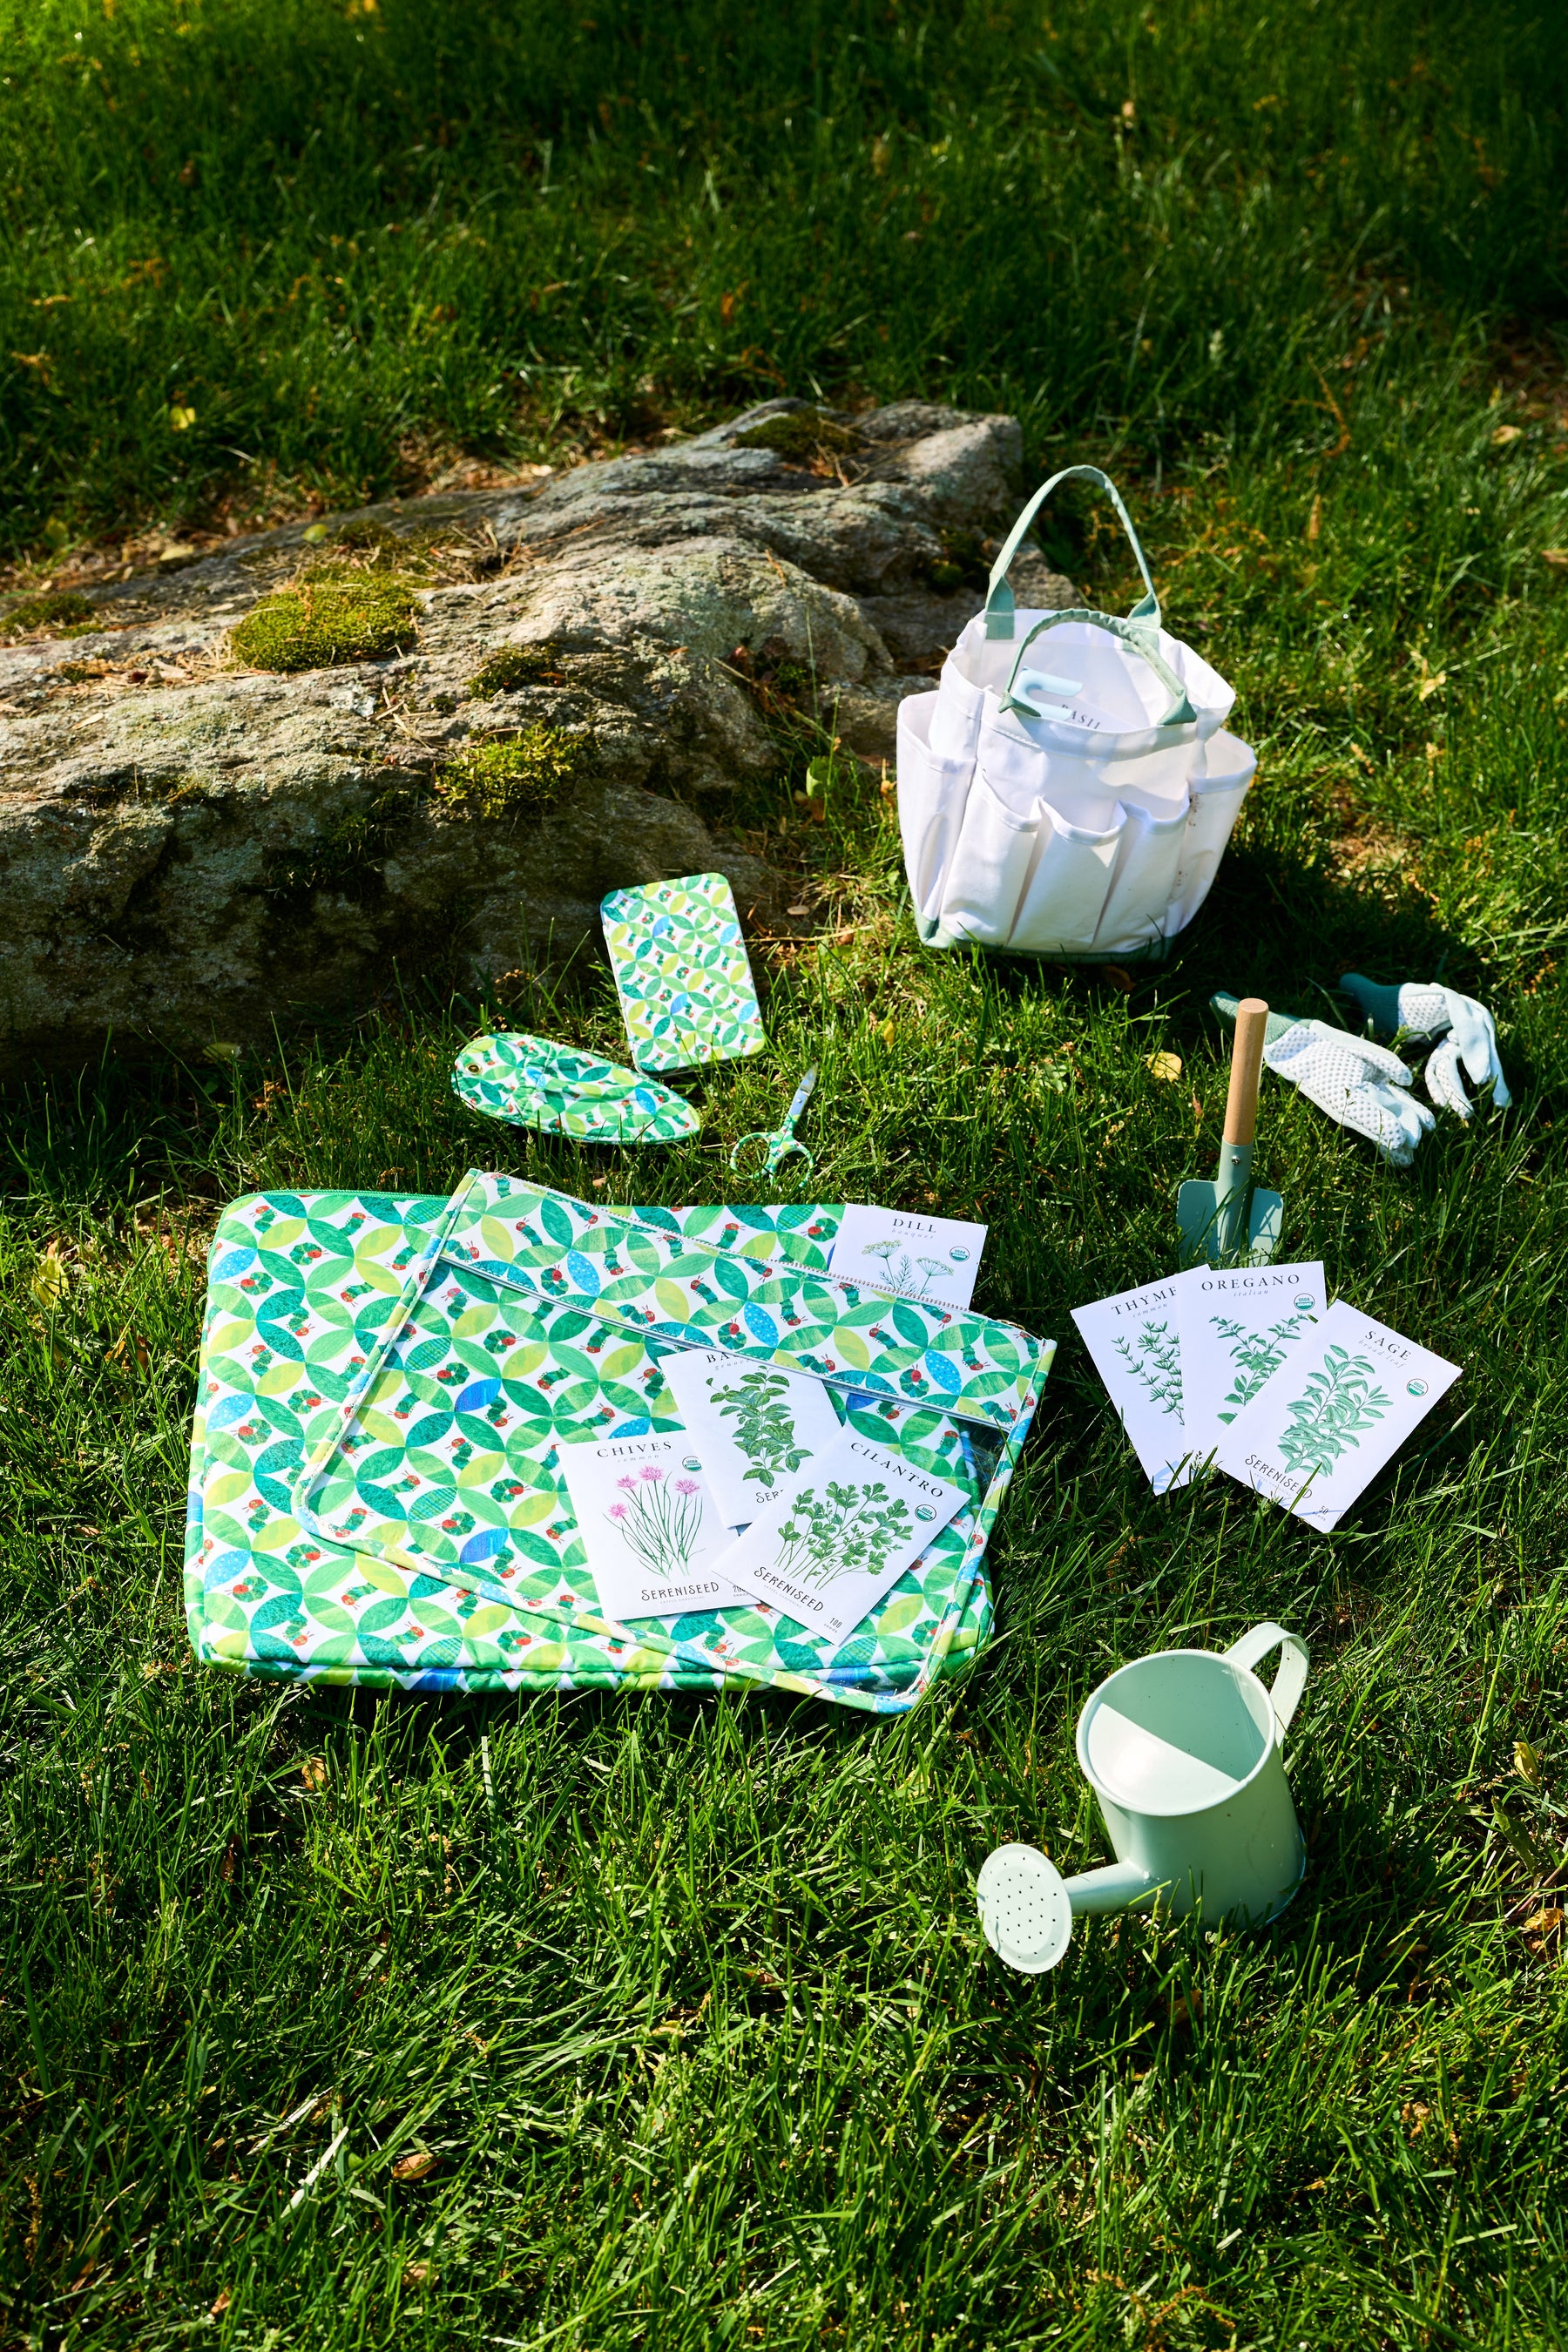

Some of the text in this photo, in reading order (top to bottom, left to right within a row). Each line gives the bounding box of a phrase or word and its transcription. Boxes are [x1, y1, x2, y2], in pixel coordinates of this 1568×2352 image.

[893, 1218, 936, 1233] DILL
[1201, 1274, 1300, 1291] OREGANO
[1365, 1330, 1411, 1361] SAGE
[597, 1441, 672, 1457] CHIVES
[850, 1442, 943, 1497] CILANTRO
[641, 1581, 720, 1601] SERENISEED
[754, 1566, 824, 1612] SERENISEED
[829, 1617, 843, 1629] 100
